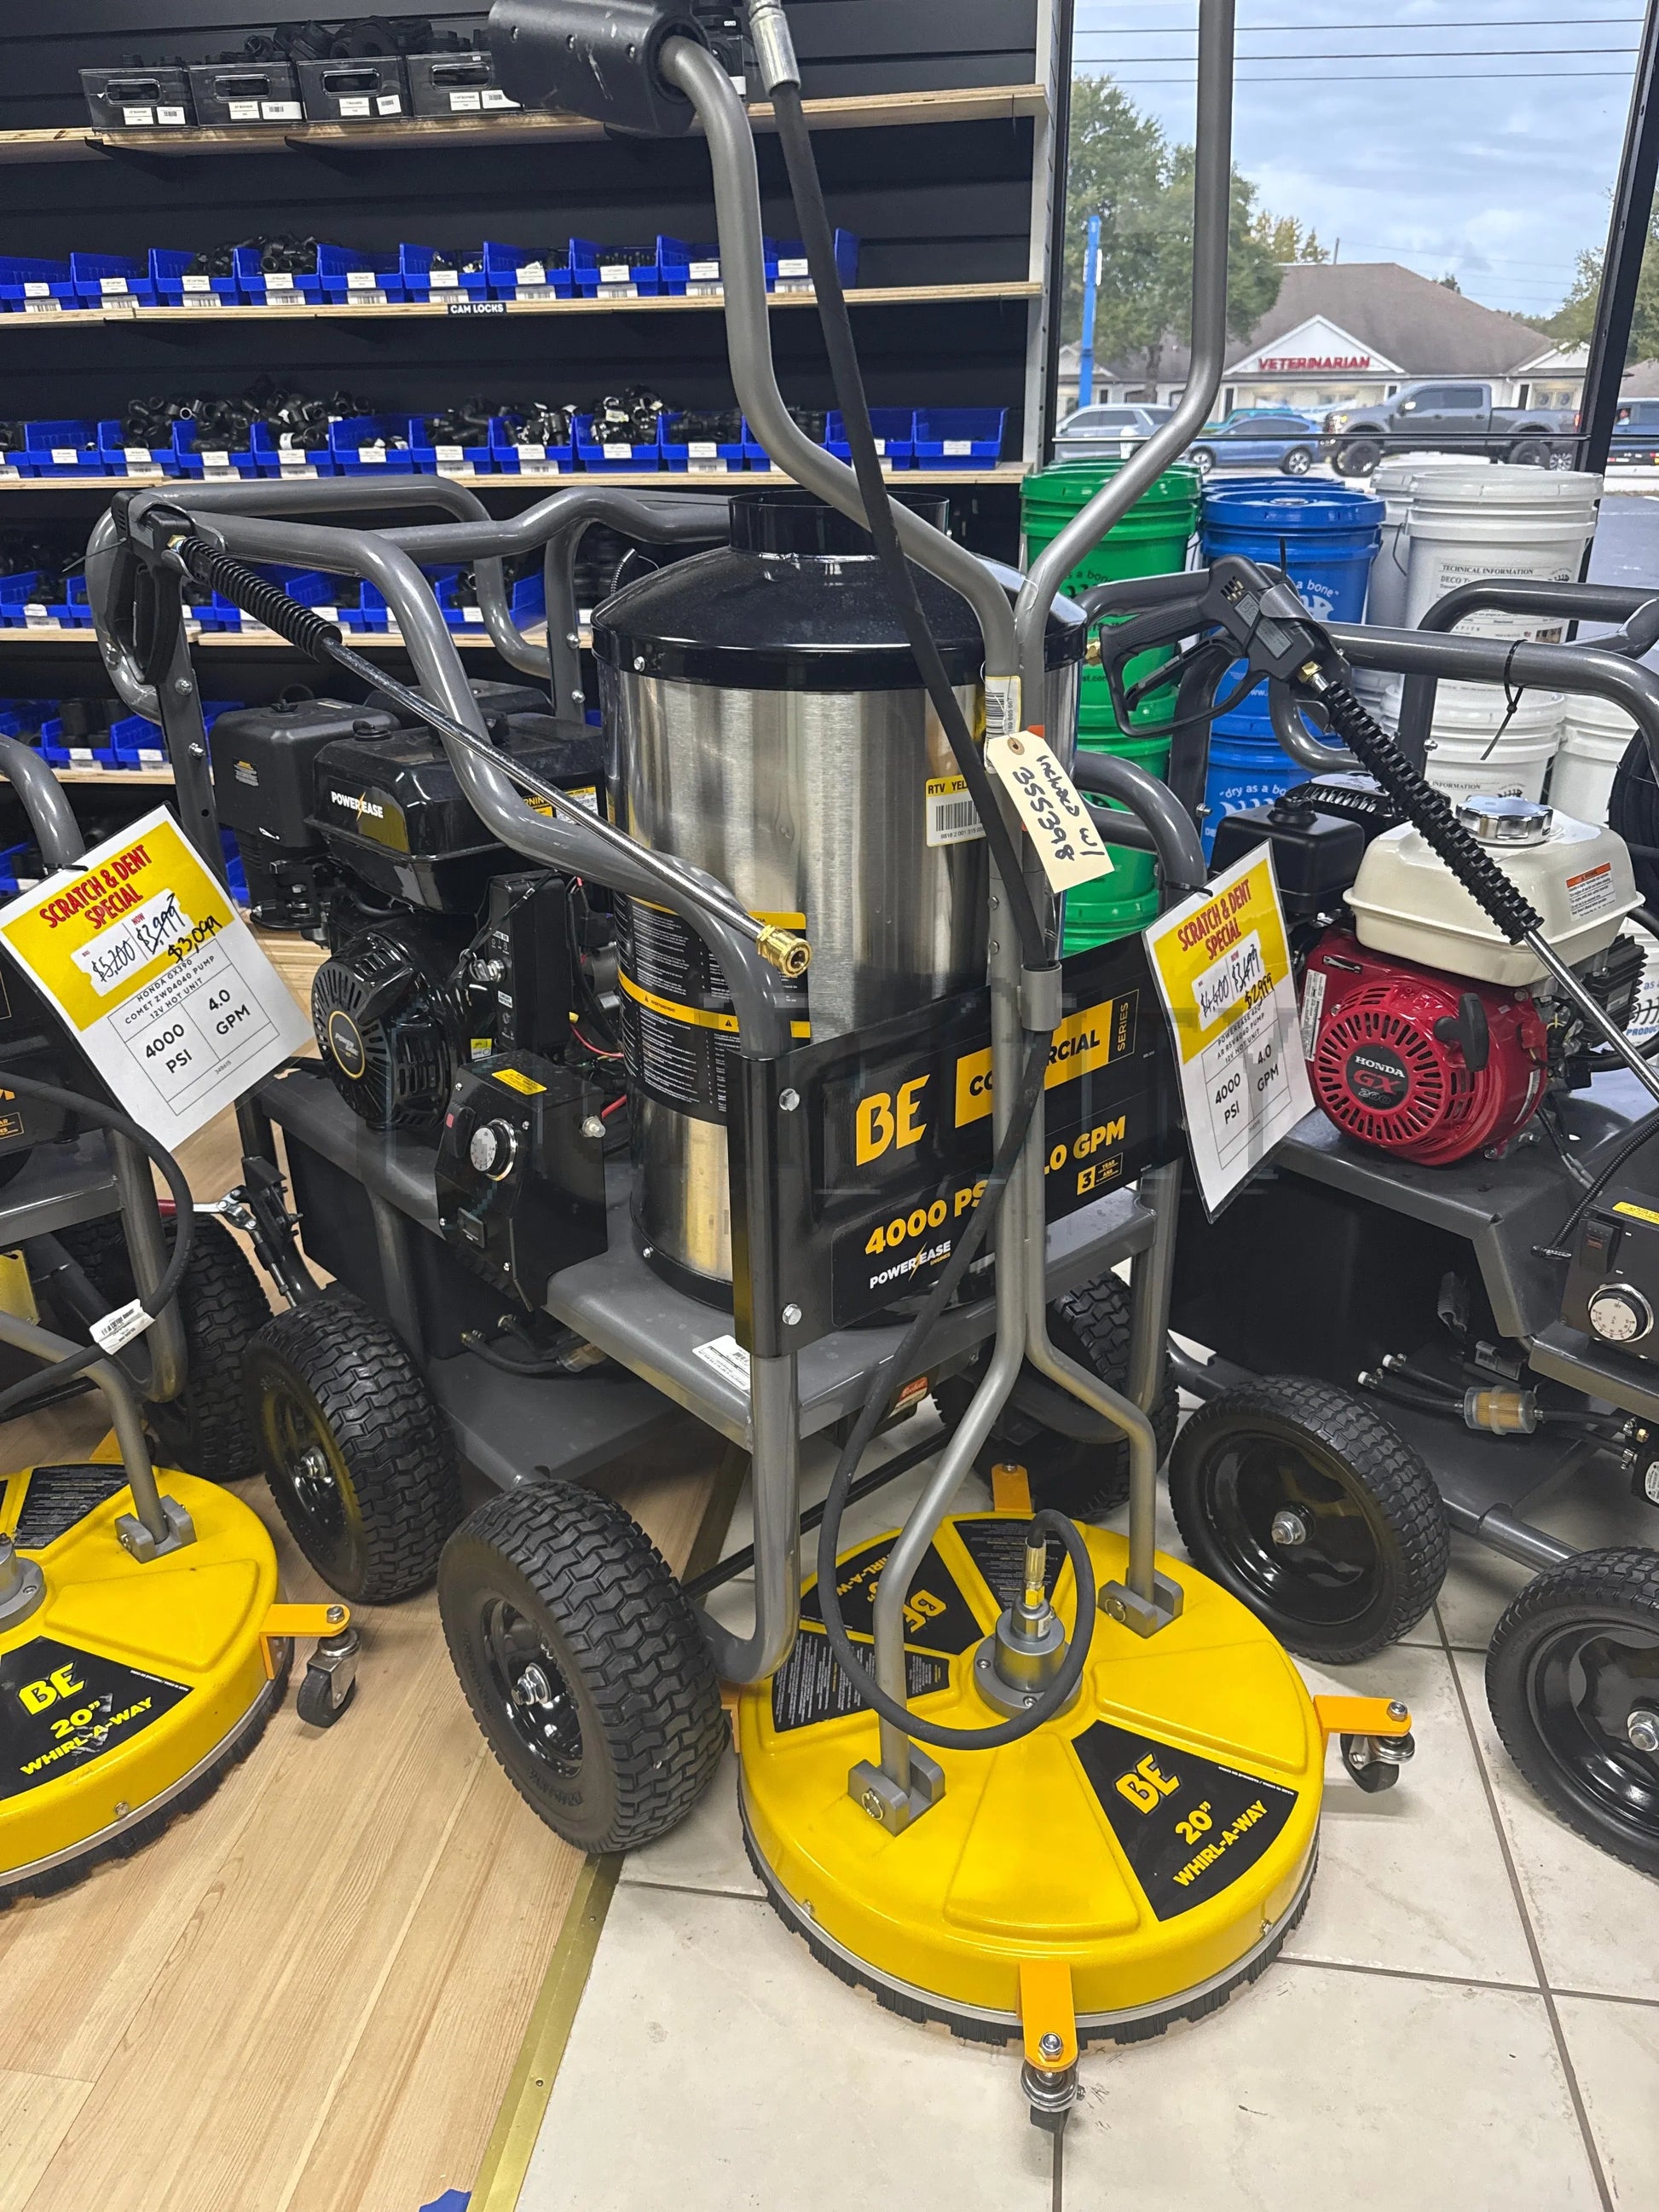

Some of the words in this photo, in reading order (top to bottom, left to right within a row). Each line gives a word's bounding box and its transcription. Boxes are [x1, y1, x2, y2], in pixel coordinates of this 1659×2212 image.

[450, 304, 471, 315] CAM
[472, 303, 504, 314] LOCKS
[1258, 356, 1371, 371] VETERINARIAN
[1296, 580, 1303, 589] a
[1442, 564, 1482, 575] TECHNICAL
[928, 783, 945, 794] RTV
[1246, 785, 1258, 794] as
[1432, 781, 1481, 790] INFORMATION
[1012, 766, 1075, 861] 355398
[39, 876, 104, 929] SCRATCH
[100, 869, 119, 889] &
[111, 844, 153, 881] DENT
[84, 883, 144, 930] SPECIAL
[131, 912, 146, 926] NOW
[1177, 904, 1222, 952] SCRATCH
[1220, 898, 1230, 921] &
[1228, 879, 1251, 915] DENT
[167, 915, 223, 963] $3,099
[1205, 917, 1242, 961] SPECIAL
[124, 1000, 153, 1025] COMET
[155, 973, 193, 1002] ZWD4040
[193, 955, 216, 975] PUMP
[136, 979, 166, 1002] HONDA
[167, 959, 193, 980] GX390
[1644, 981, 1655, 990] as
[149, 1007, 165, 1020] 12V
[166, 992, 182, 1009] HOT
[185, 977, 204, 996] UNIT
[208, 989, 231, 1012] 4.0
[216, 1004, 251, 1036] GPM
[1117, 1002, 1129, 1052] SERIES
[1217, 1014, 1251, 1046] POWEREASE
[145, 1023, 185, 1060] 4000
[1217, 1049, 1225, 1060] AR
[1251, 1013, 1265, 1030] PUMP
[1225, 1052, 1234, 1064] 12V
[1235, 1042, 1246, 1056] HOT
[1247, 1029, 1260, 1043] UNIT
[165, 1048, 193, 1074] PSI
[1257, 1044, 1272, 1065] 4.0
[1355, 1055, 1406, 1078] HONDA
[1215, 1072, 1241, 1105] 4000
[1257, 1063, 1279, 1092] GPM
[1353, 1069, 1402, 1095] GX
[1224, 1100, 1240, 1124] PSI
[1358, 1088, 1391, 1104] 200
[856, 1073, 930, 1166] BE
[864, 1199, 947, 1255] 4000
[954, 1179, 989, 1217] PS
[1072, 1115, 1125, 1159] GPM
[1082, 1171, 1092, 1189] 3
[19, 1662, 85, 1715] BE
[20, 1696, 152, 1775] WHIRL-A-WAY
[1115, 1753, 1181, 1814] BE
[1172, 1799, 1268, 1886] WHIRL-A-WAY
